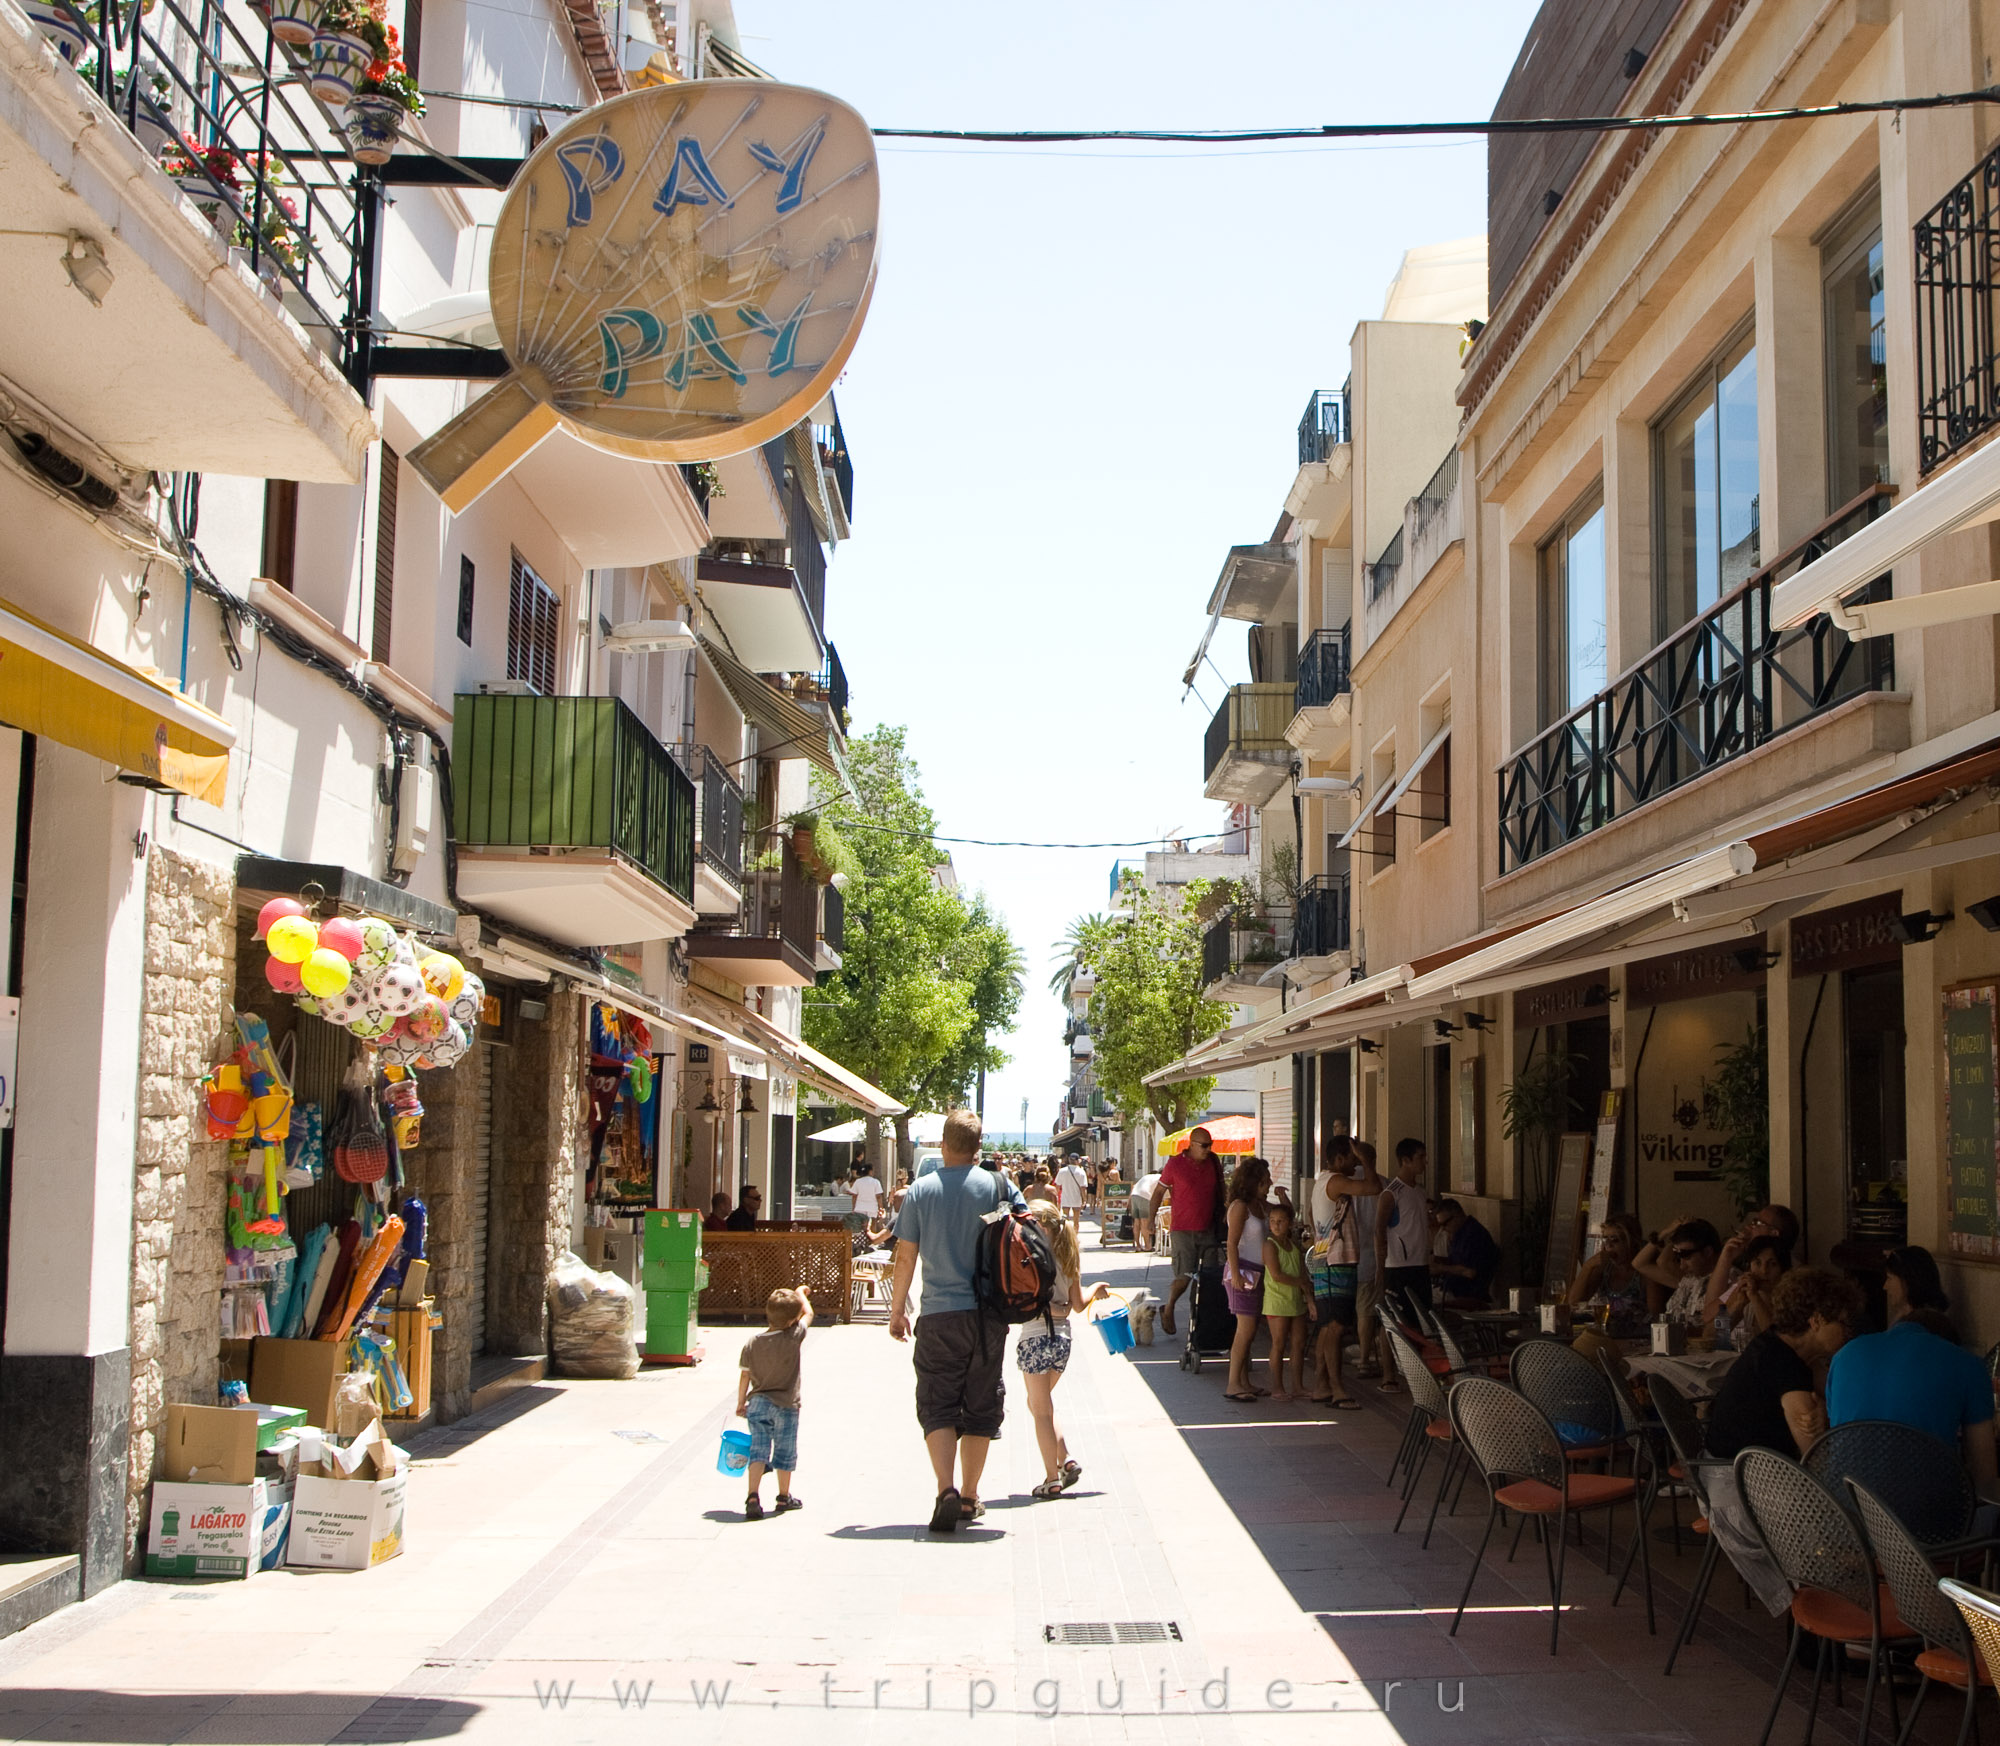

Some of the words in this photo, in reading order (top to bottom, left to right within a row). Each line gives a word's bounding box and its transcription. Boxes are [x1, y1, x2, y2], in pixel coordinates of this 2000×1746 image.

[555, 129, 826, 227] PAY
[596, 291, 816, 399] PAY
[1831, 921, 1850, 954] DE
[691, 1048, 707, 1058] RB
[1954, 1068, 1962, 1085] DE
[1641, 1133, 1658, 1141] LOS
[1642, 1134, 1729, 1168] viking
[190, 1513, 246, 1530] LAGARTO
[295, 1509, 322, 1518] CONTIENE
[333, 1513, 368, 1521] RECAMBIOS
[197, 1529, 243, 1541] Fregasuelos
